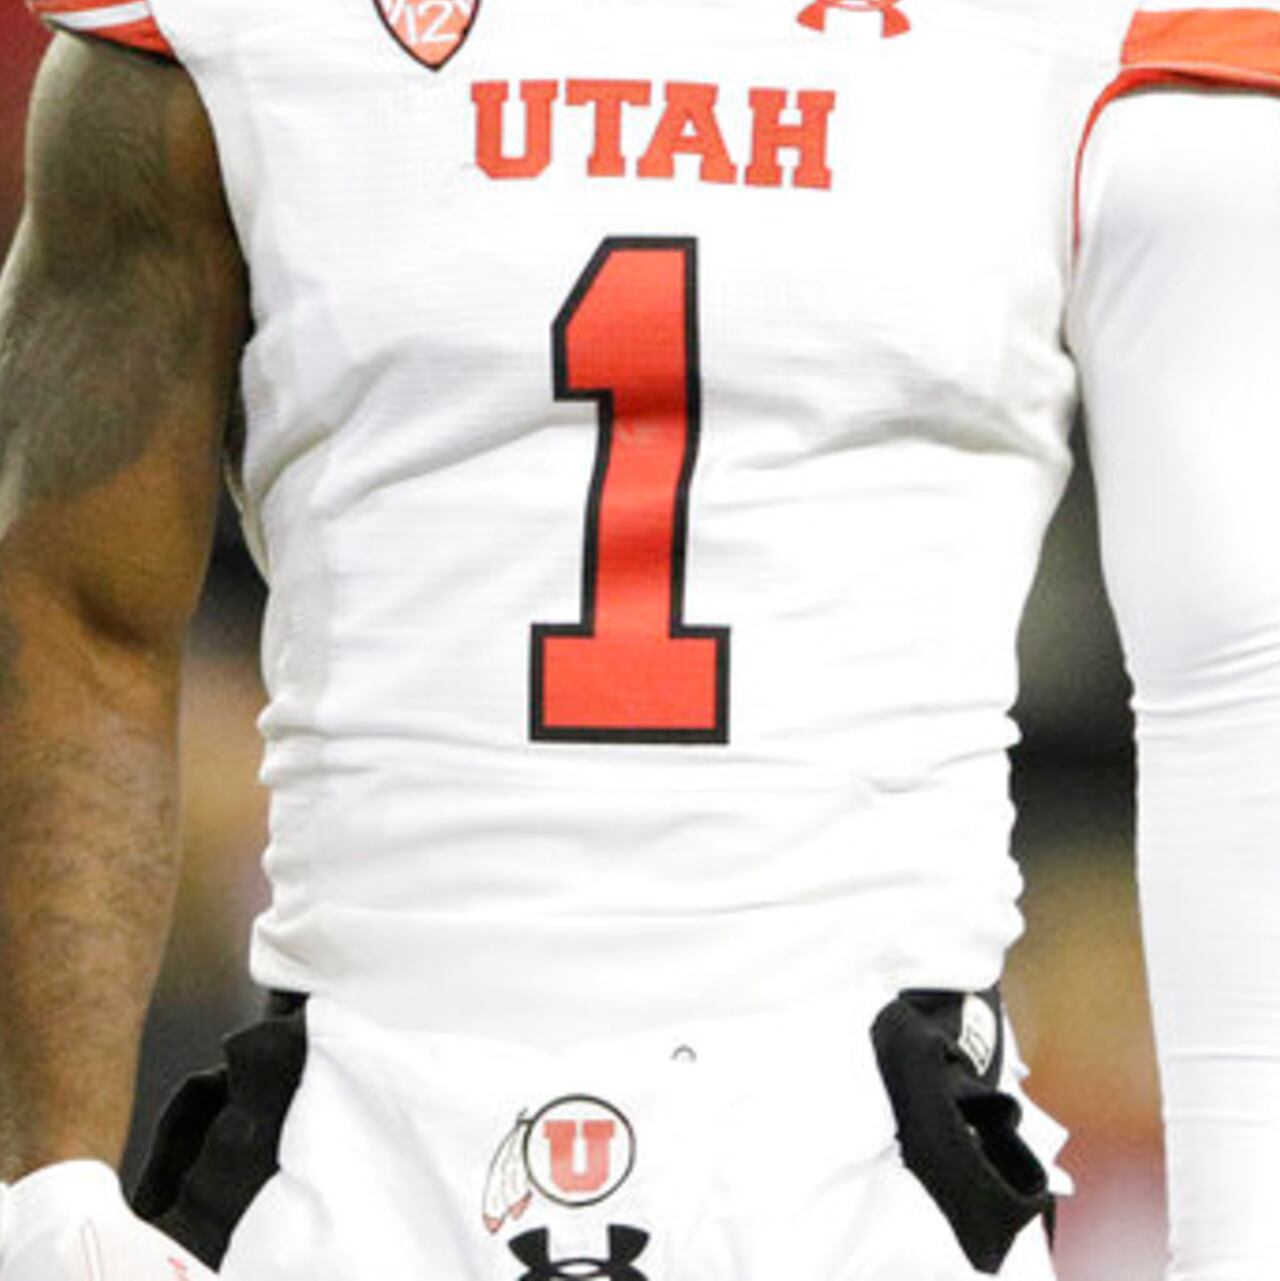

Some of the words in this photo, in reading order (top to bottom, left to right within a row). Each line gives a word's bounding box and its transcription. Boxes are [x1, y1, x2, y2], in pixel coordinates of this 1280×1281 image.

[471, 77, 837, 191] UTAH
[529, 236, 731, 745] 1
[542, 1119, 616, 1193] U
